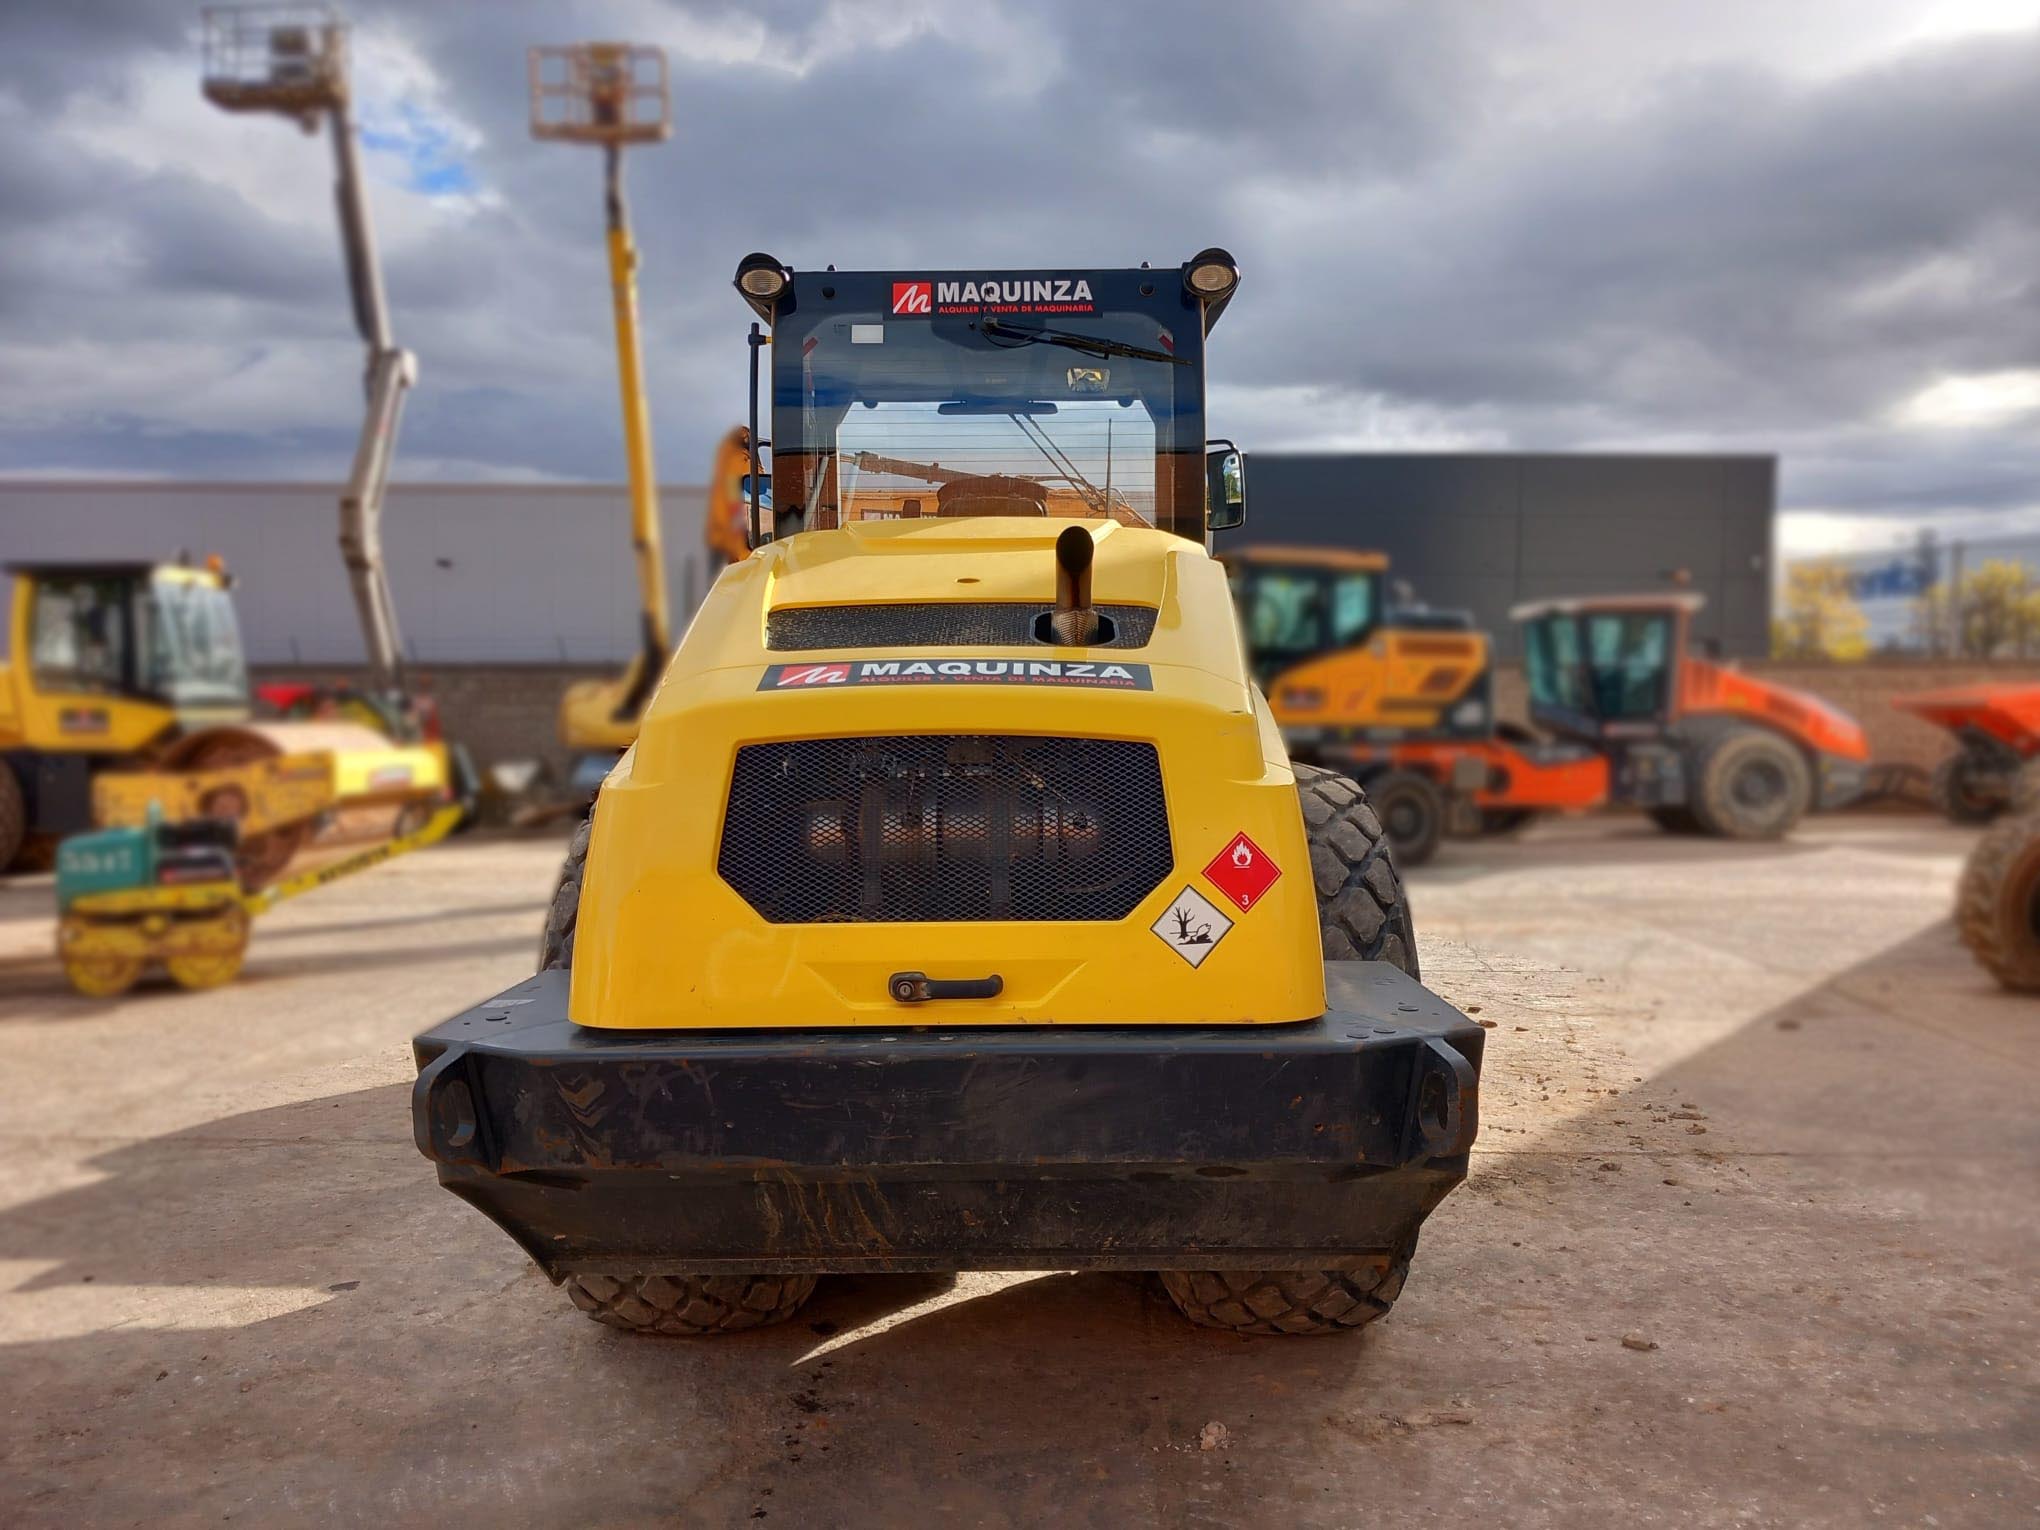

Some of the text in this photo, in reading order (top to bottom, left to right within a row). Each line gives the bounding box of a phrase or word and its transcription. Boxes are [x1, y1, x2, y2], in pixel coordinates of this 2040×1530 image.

[937, 280, 1093, 303] MAQUINZA
[938, 305, 979, 313] ALQUILER
[990, 305, 1019, 313] VENTA
[1035, 304, 1094, 312] MAQUINARIA
[860, 661, 1135, 680] MAQUINZA
[858, 674, 932, 683] ALQUILER
[953, 674, 1002, 682] VENTA
[1007, 674, 1027, 683] DE
[1031, 675, 1136, 687] MAQUINARIA
[1241, 894, 1249, 906] 3
